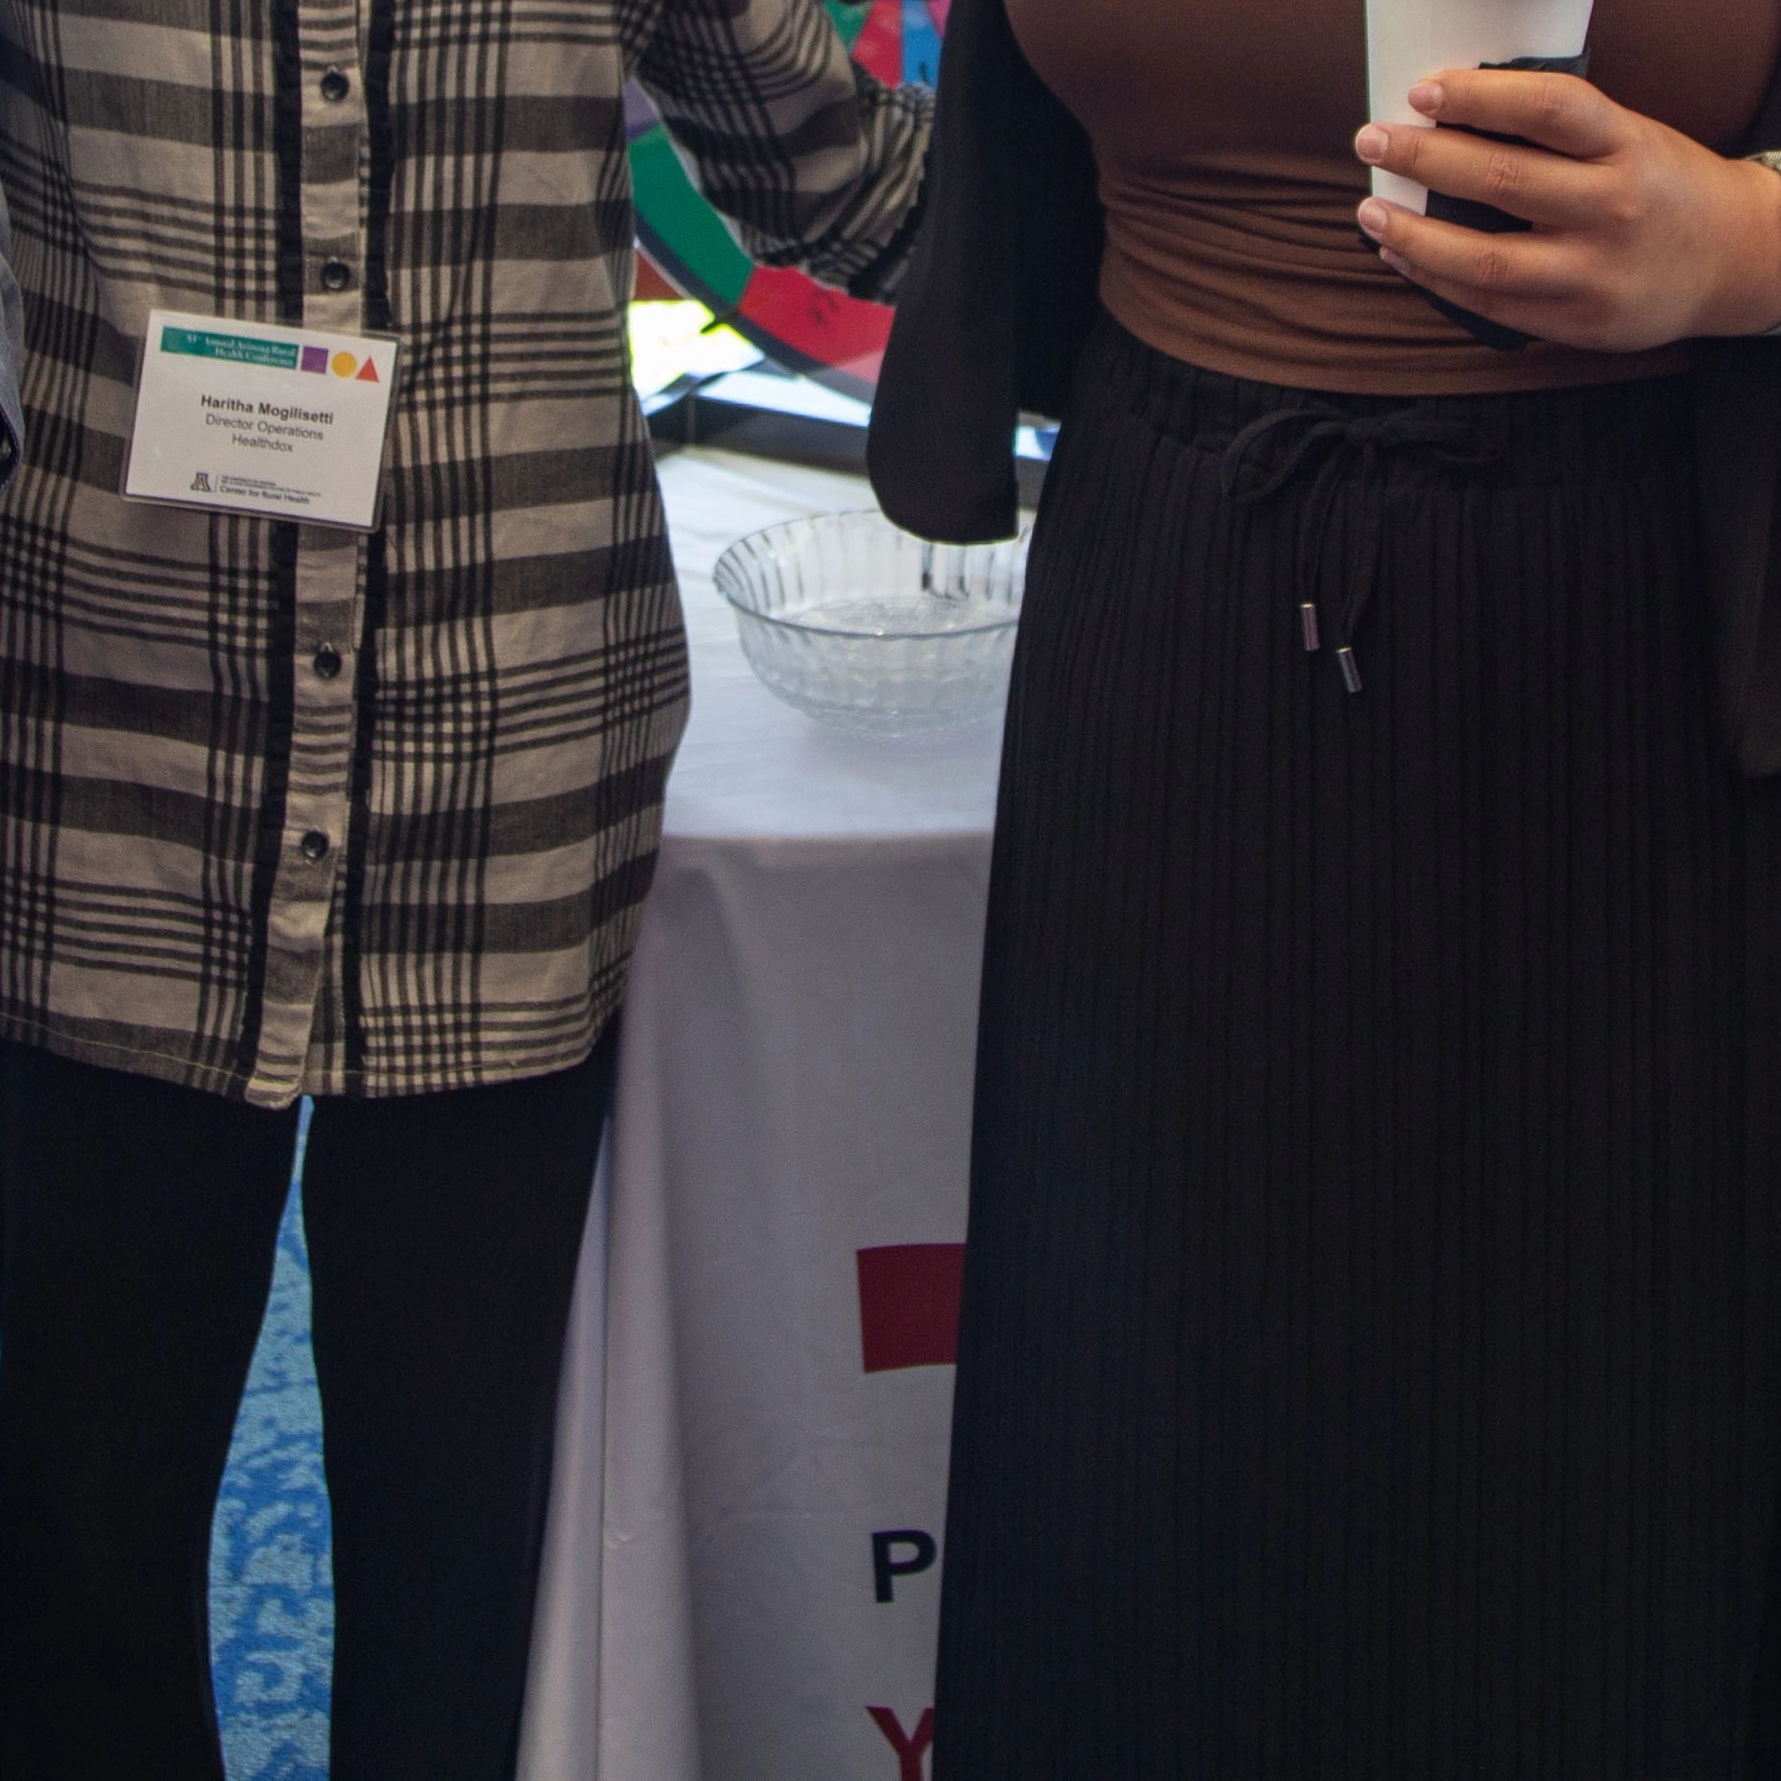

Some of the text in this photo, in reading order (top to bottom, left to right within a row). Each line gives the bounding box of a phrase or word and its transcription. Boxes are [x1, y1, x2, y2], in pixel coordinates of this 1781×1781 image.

[201, 394, 334, 425] Haritha Mogilisetti
[205, 413, 323, 441] Director Operations
[231, 433, 294, 453] Healthdox
